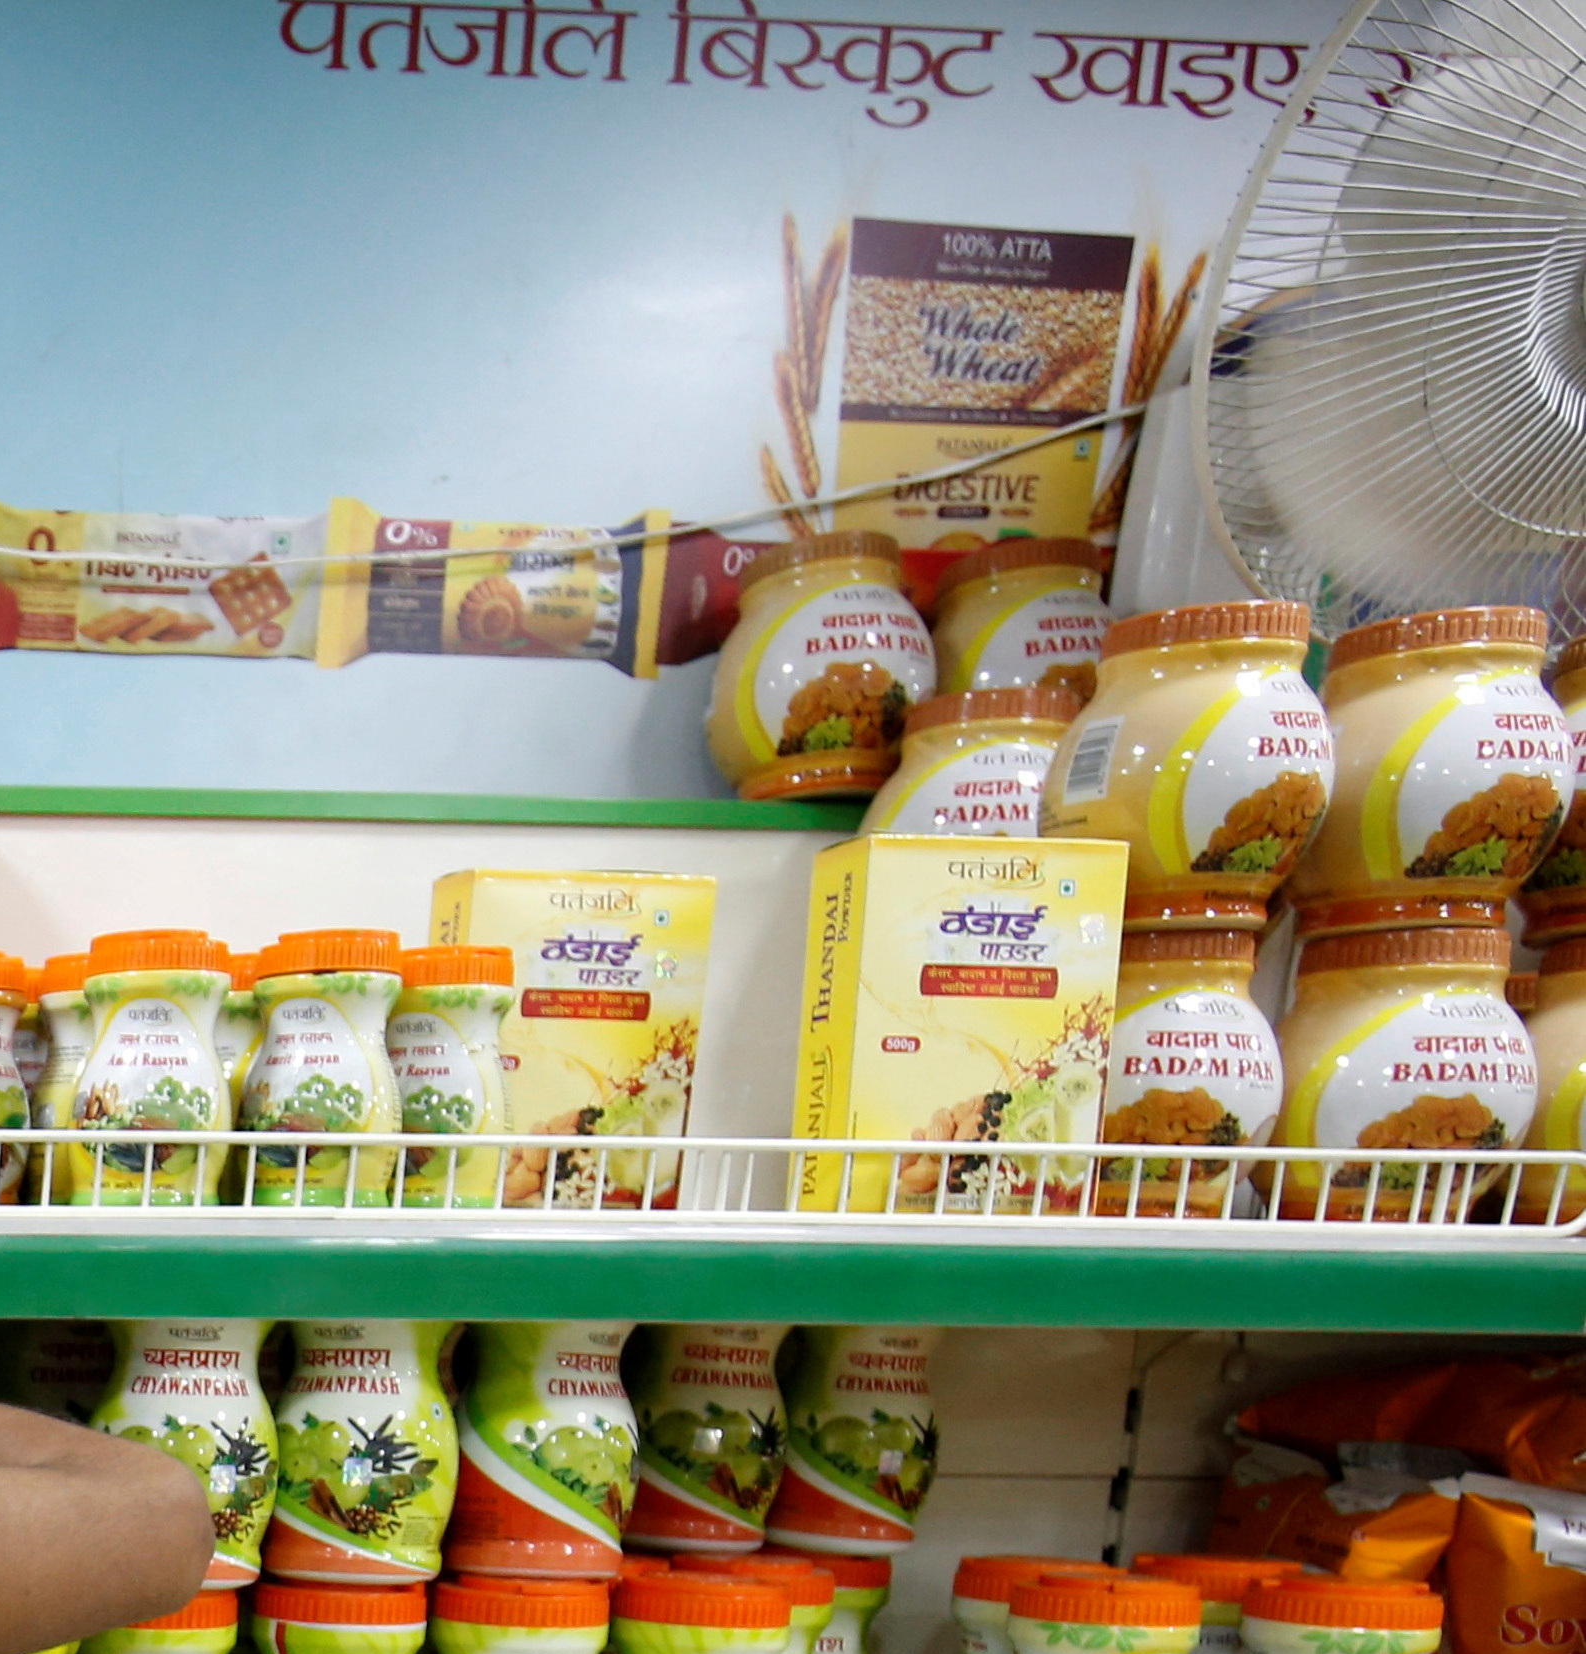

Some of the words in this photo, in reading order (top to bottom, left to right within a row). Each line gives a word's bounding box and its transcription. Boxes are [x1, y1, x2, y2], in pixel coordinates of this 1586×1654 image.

[941, 230, 995, 260] 100%
[999, 236, 1054, 264] ATTA
[919, 303, 1024, 346] Whole
[924, 340, 1040, 385] Wheat
[806, 635, 891, 657] BADAM
[1493, 713, 1555, 734] बादाम
[947, 856, 1044, 884] पतंजलि
[550, 891, 638, 916] पतंजलि
[939, 903, 1048, 941] ठंडाई
[541, 927, 643, 967] ठंडाई
[980, 941, 1046, 963] पाउडर
[578, 966, 640, 988] पाउडर
[885, 1038, 917, 1052] 500g
[1146, 1031, 1217, 1050] बादाम
[1414, 1035, 1486, 1054] बादाम
[1125, 1055, 1228, 1077] BADAM
[1237, 1059, 1274, 1081] PAK
[1392, 1060, 1497, 1083] BADAM
[1503, 1063, 1537, 1086] PAK
[143, 1348, 241, 1371] च्यवनप्राश
